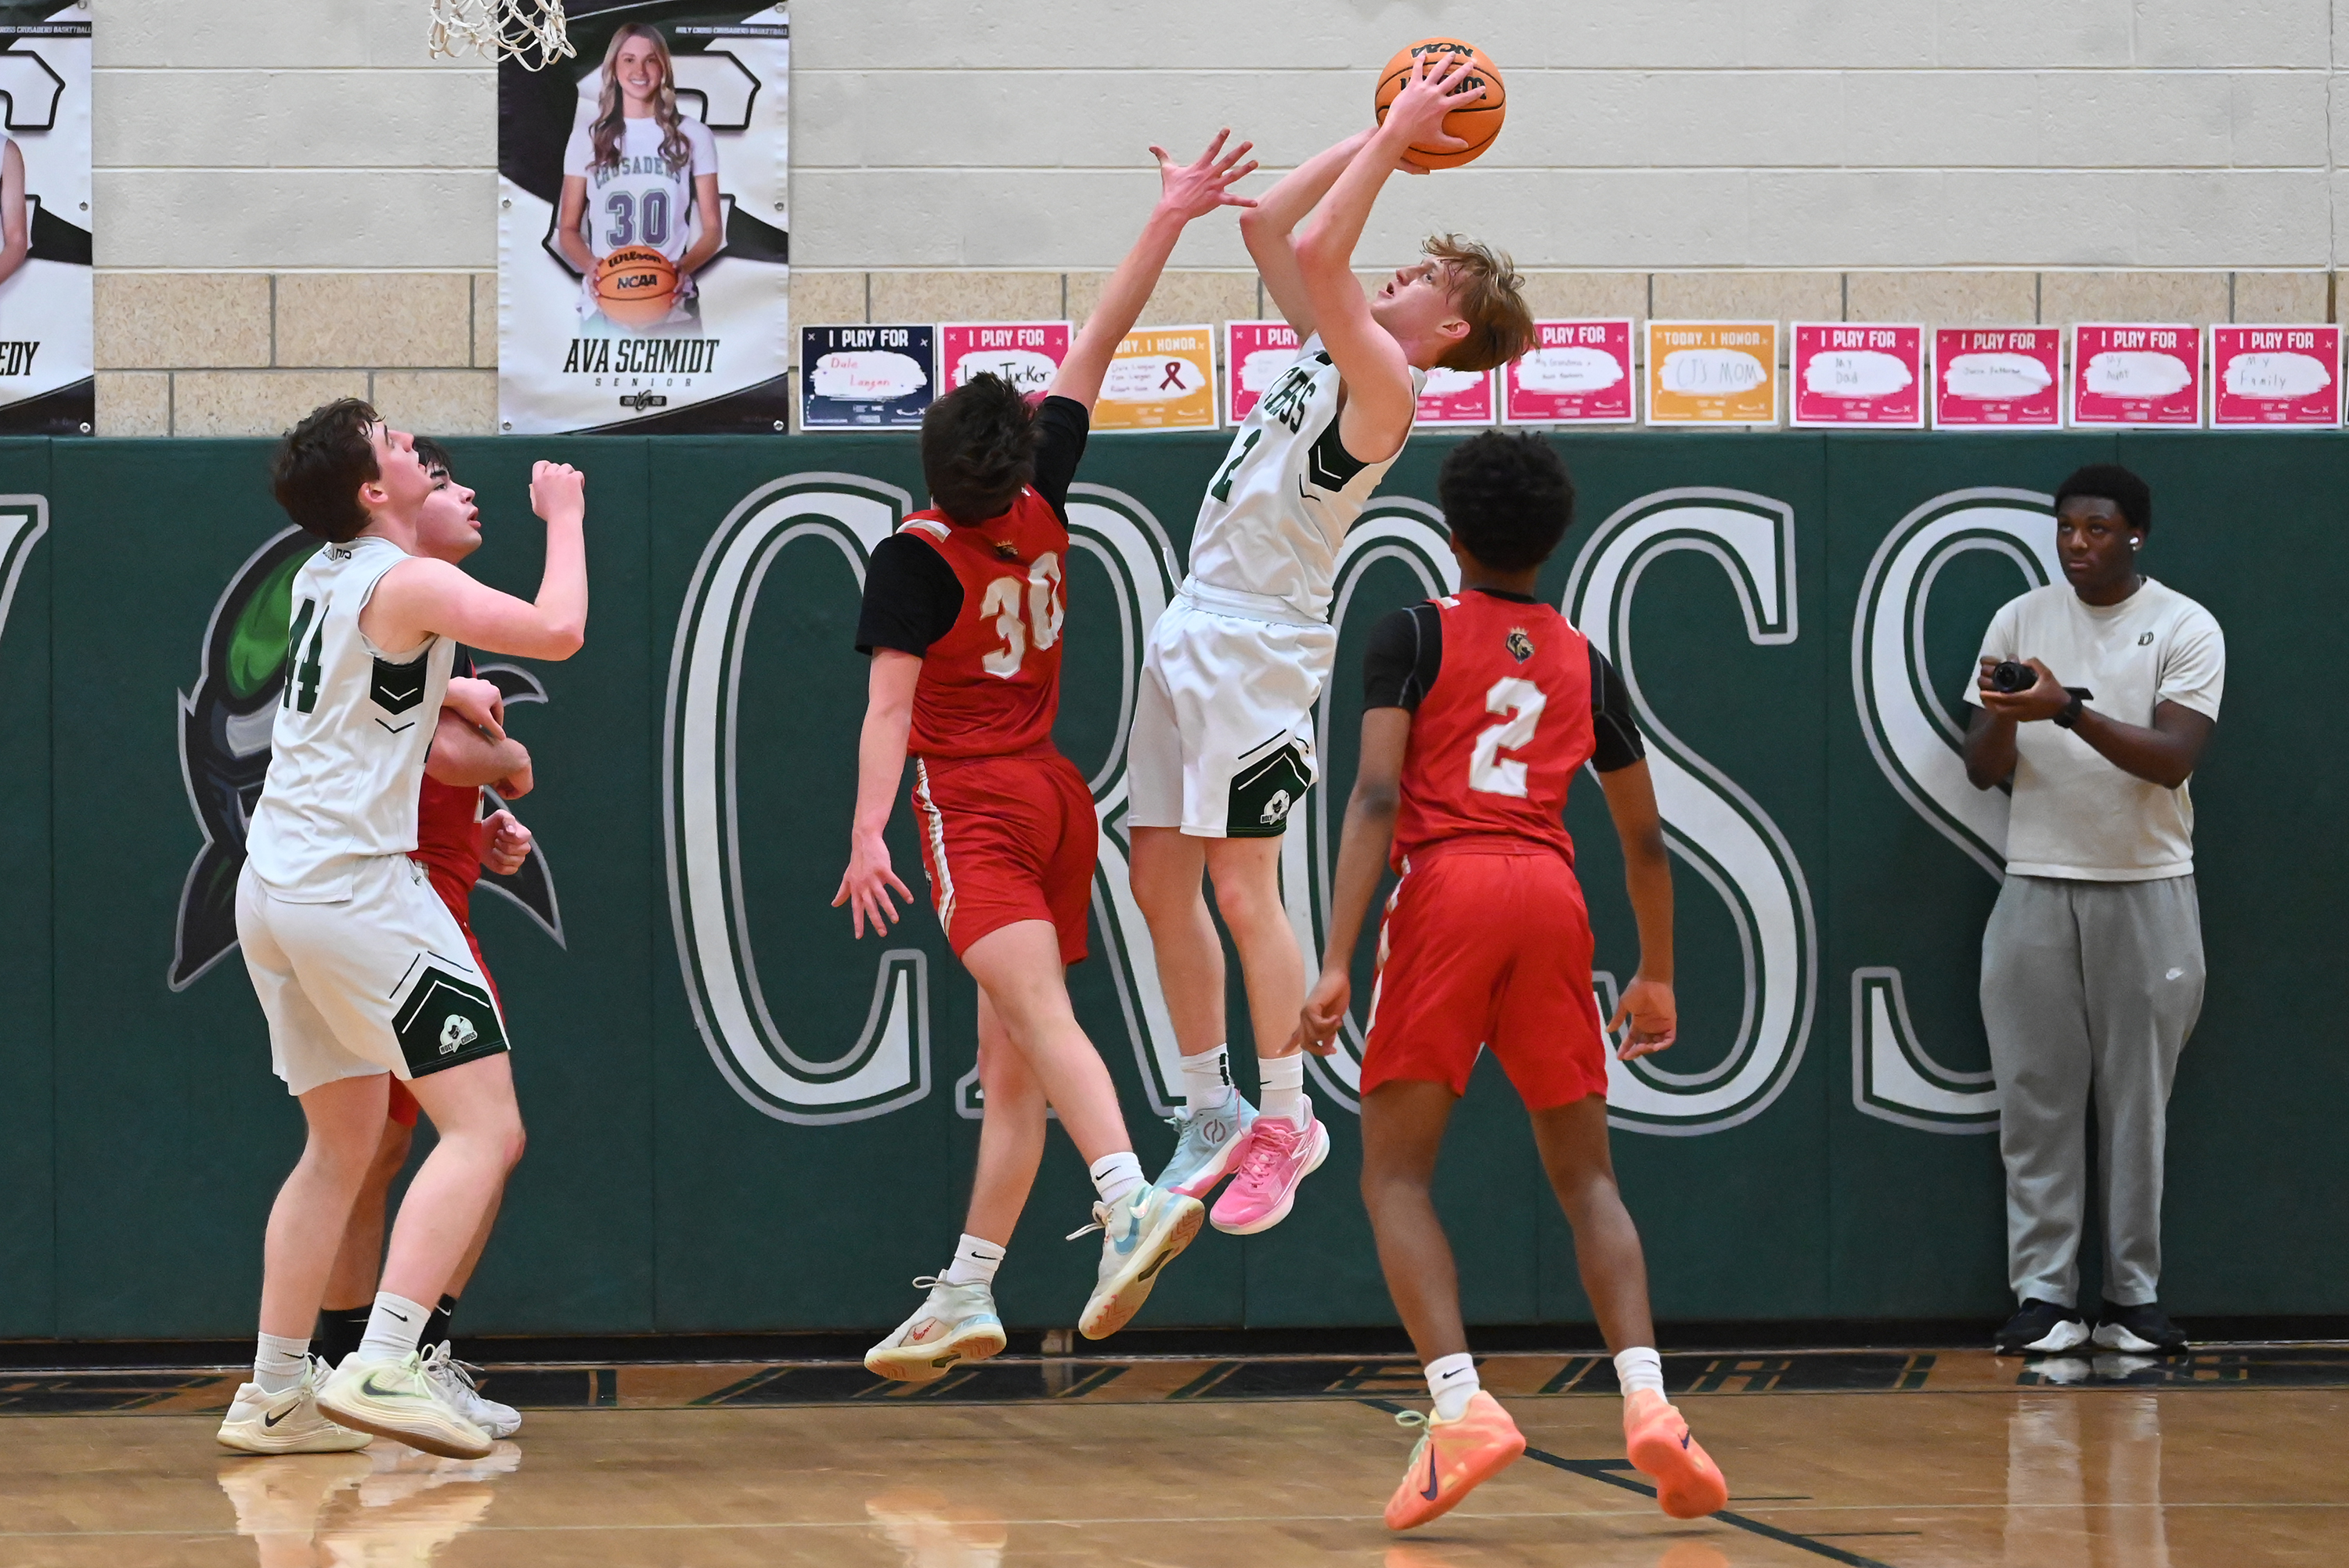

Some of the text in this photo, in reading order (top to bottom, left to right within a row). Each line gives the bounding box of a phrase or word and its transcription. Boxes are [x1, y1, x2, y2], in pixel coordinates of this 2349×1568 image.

[605, 189, 670, 250] 30
[617, 274, 658, 290] NCAA
[828, 330, 909, 348] I PLAY FOR
[969, 330, 1045, 347] I PLAY FOR
[1255, 328, 1299, 345] I PLAY
[1543, 326, 1606, 344] PLAY FOR
[1711, 332, 1716, 345] I
[1720, 332, 1760, 346] HONOR
[1820, 330, 1896, 348] I PLAY FOR
[1961, 332, 2036, 350] I PLAY FOR
[2101, 330, 2177, 348] I PLAY FOR
[2239, 331, 2315, 349] I PLAY FOR
[1146, 339, 1152, 352] I
[1156, 337, 1197, 351] HONOR
[563, 339, 720, 373] AVA SCHMIDT
[2246, 356, 2270, 368] My
[595, 377, 692, 387] SENIOR
[1719, 362, 1759, 385] MOM
[1835, 370, 1858, 384] Dad
[2240, 369, 2286, 390] Family
[980, 550, 1065, 679] 30
[1469, 676, 1547, 798] 2
